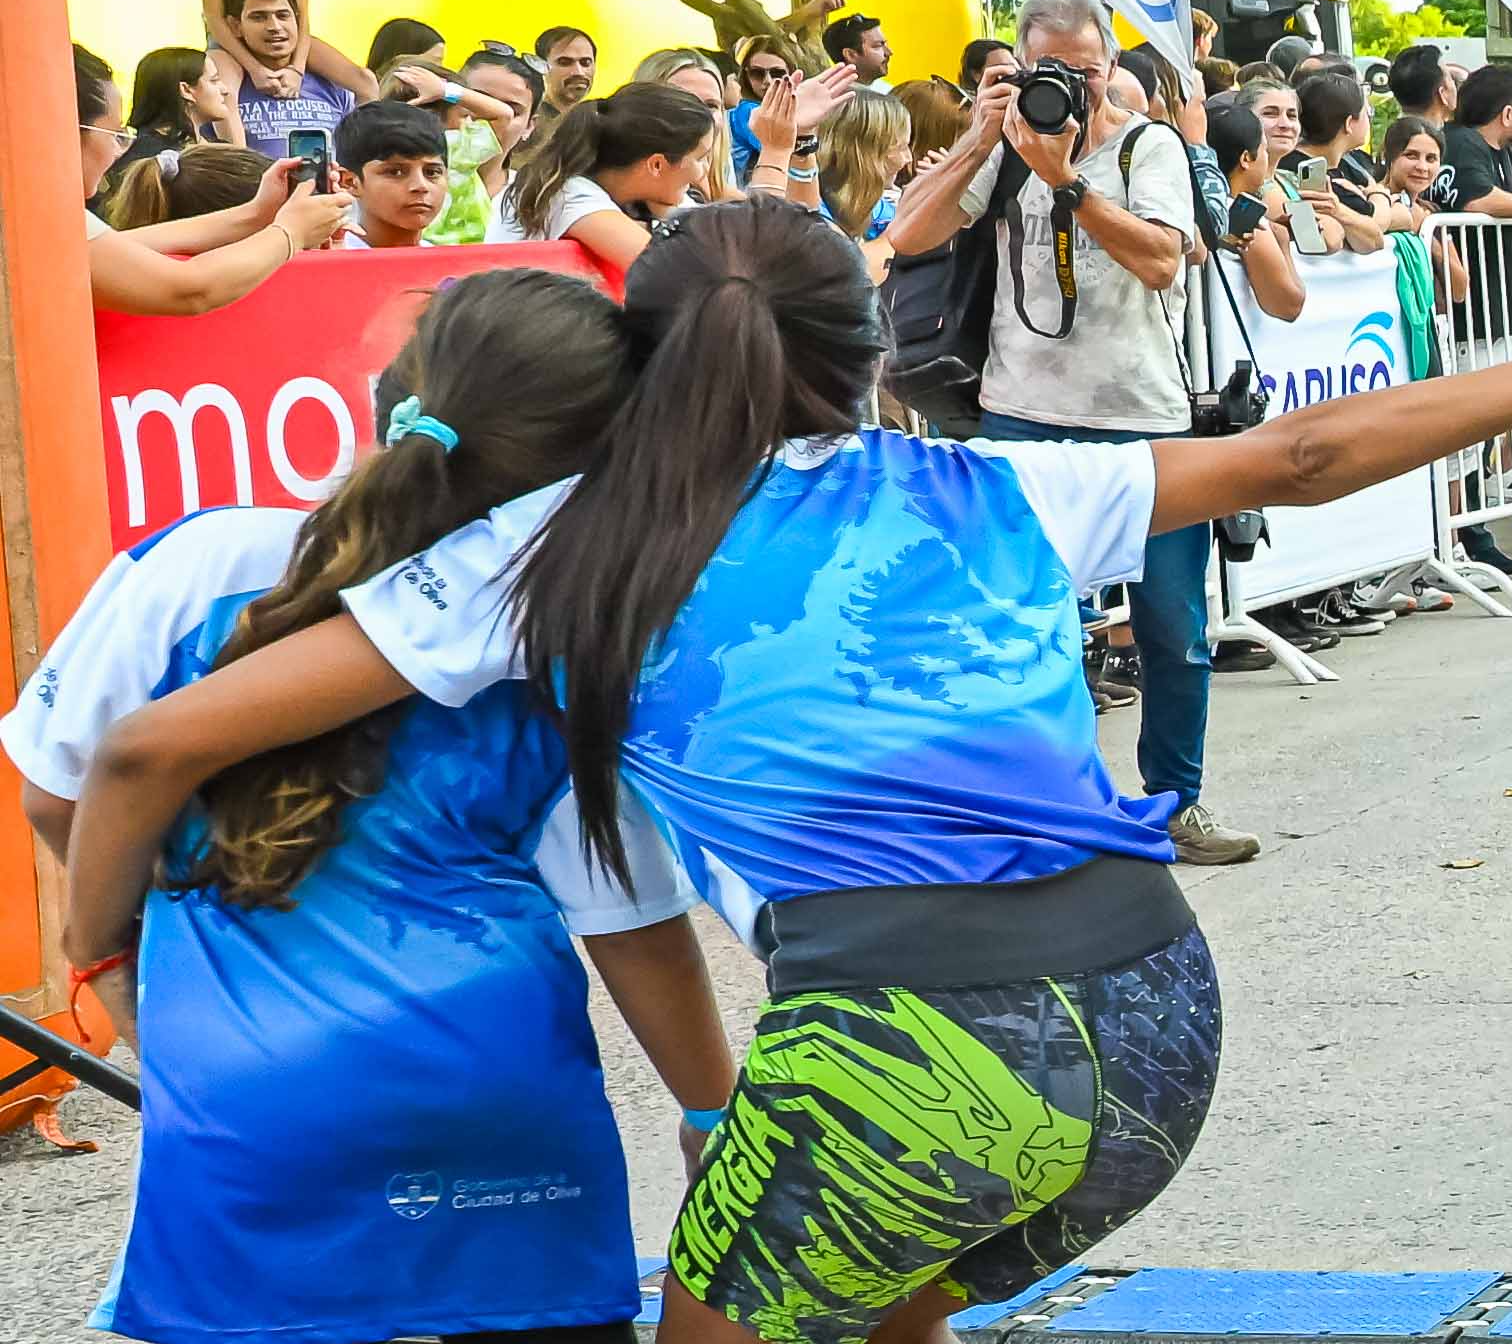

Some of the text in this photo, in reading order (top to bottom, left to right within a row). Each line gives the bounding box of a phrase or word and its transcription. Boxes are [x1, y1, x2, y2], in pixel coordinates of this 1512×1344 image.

[278, 99, 332, 112] FOCUSED
[1058, 231, 1069, 264] Nikon
[452, 1191, 515, 1209] Ciudad
[520, 1190, 540, 1203] de
